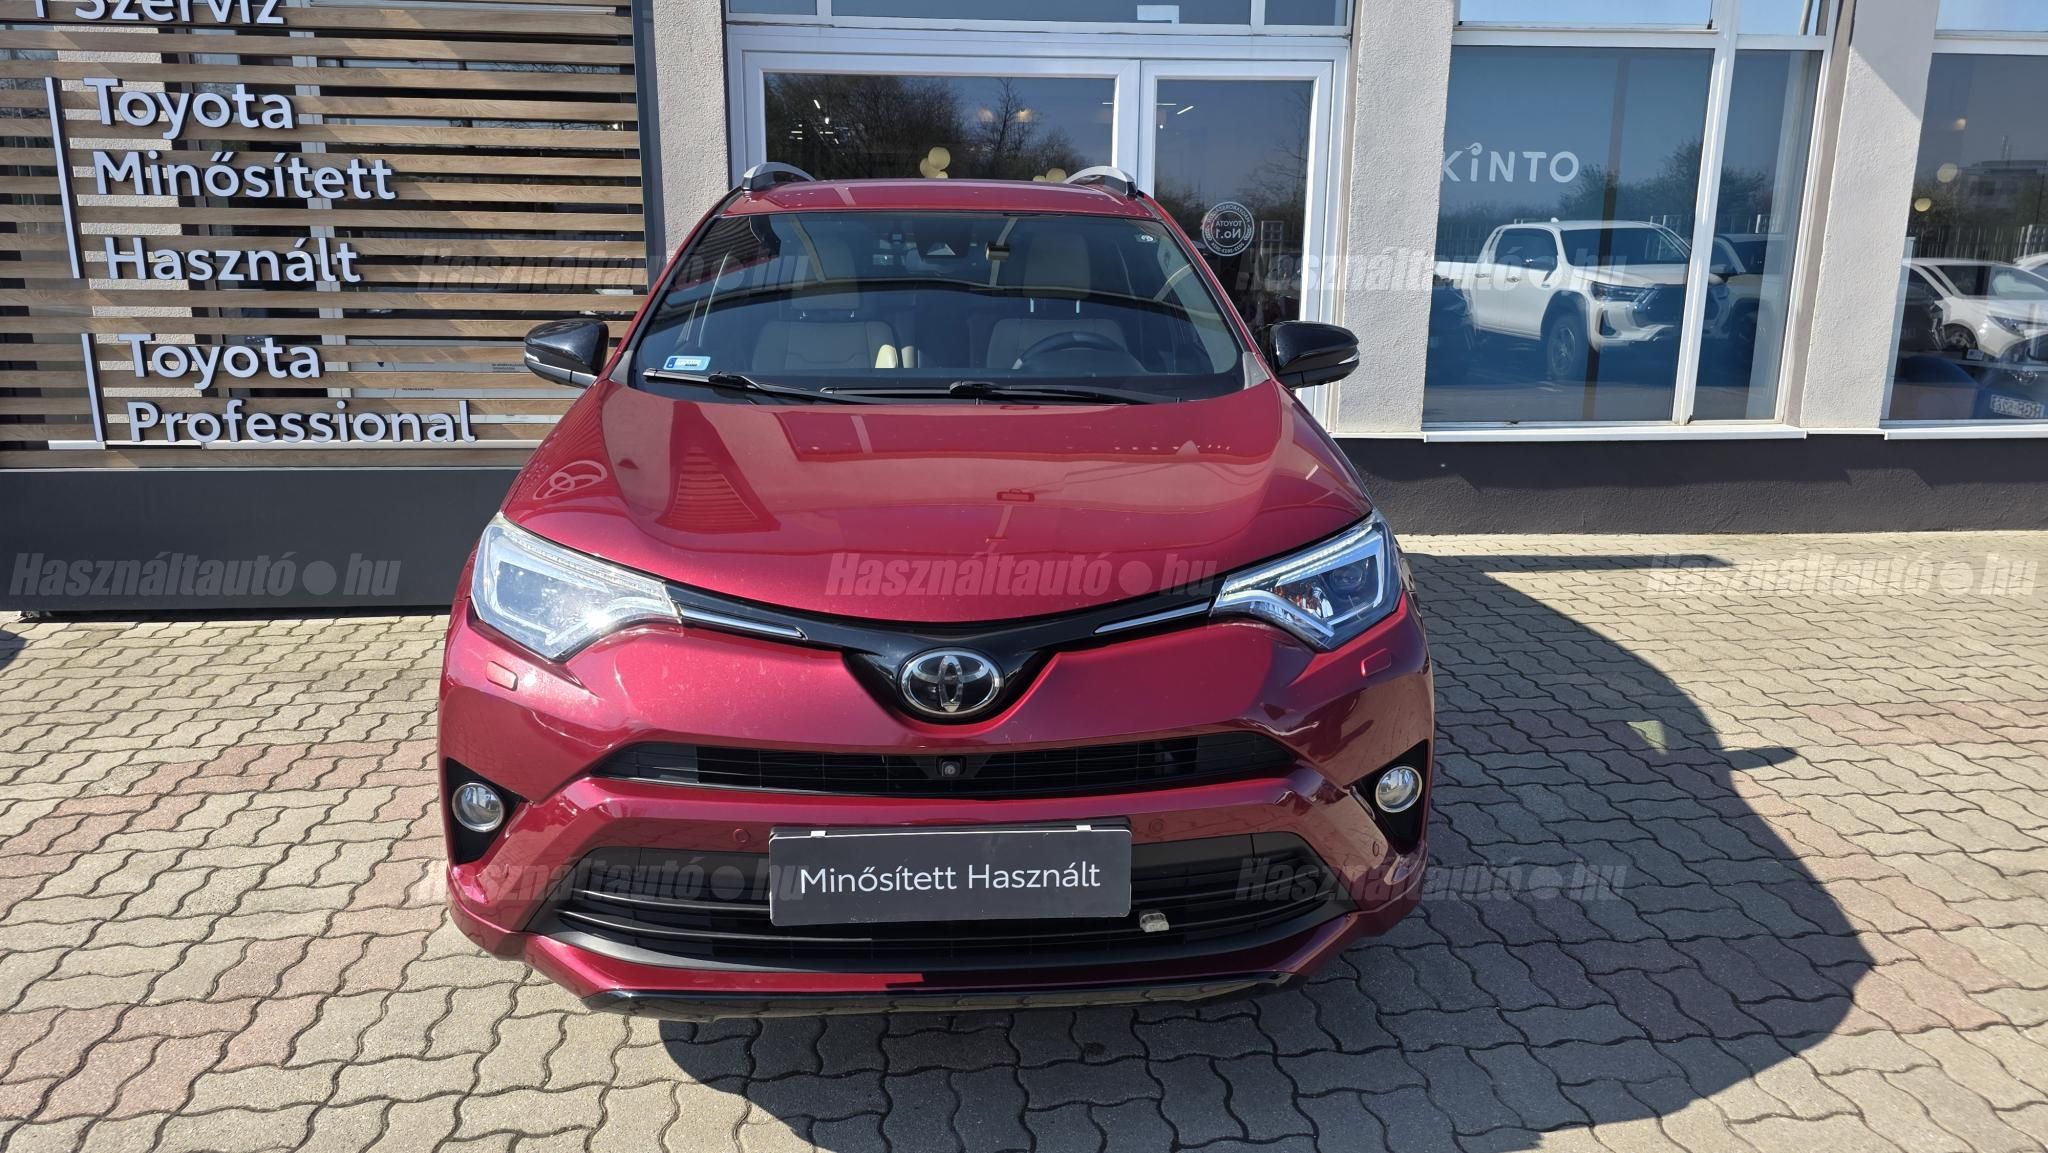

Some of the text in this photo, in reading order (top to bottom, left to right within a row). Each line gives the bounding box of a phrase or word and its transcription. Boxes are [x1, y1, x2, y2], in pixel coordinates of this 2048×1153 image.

[83, 77, 296, 138] Toyota
[93, 151, 397, 200] Minősített
[104, 237, 363, 284] Használt
[118, 333, 322, 390] Toyota
[127, 400, 478, 445] Professional
[799, 860, 1102, 895] Minősített Használt
